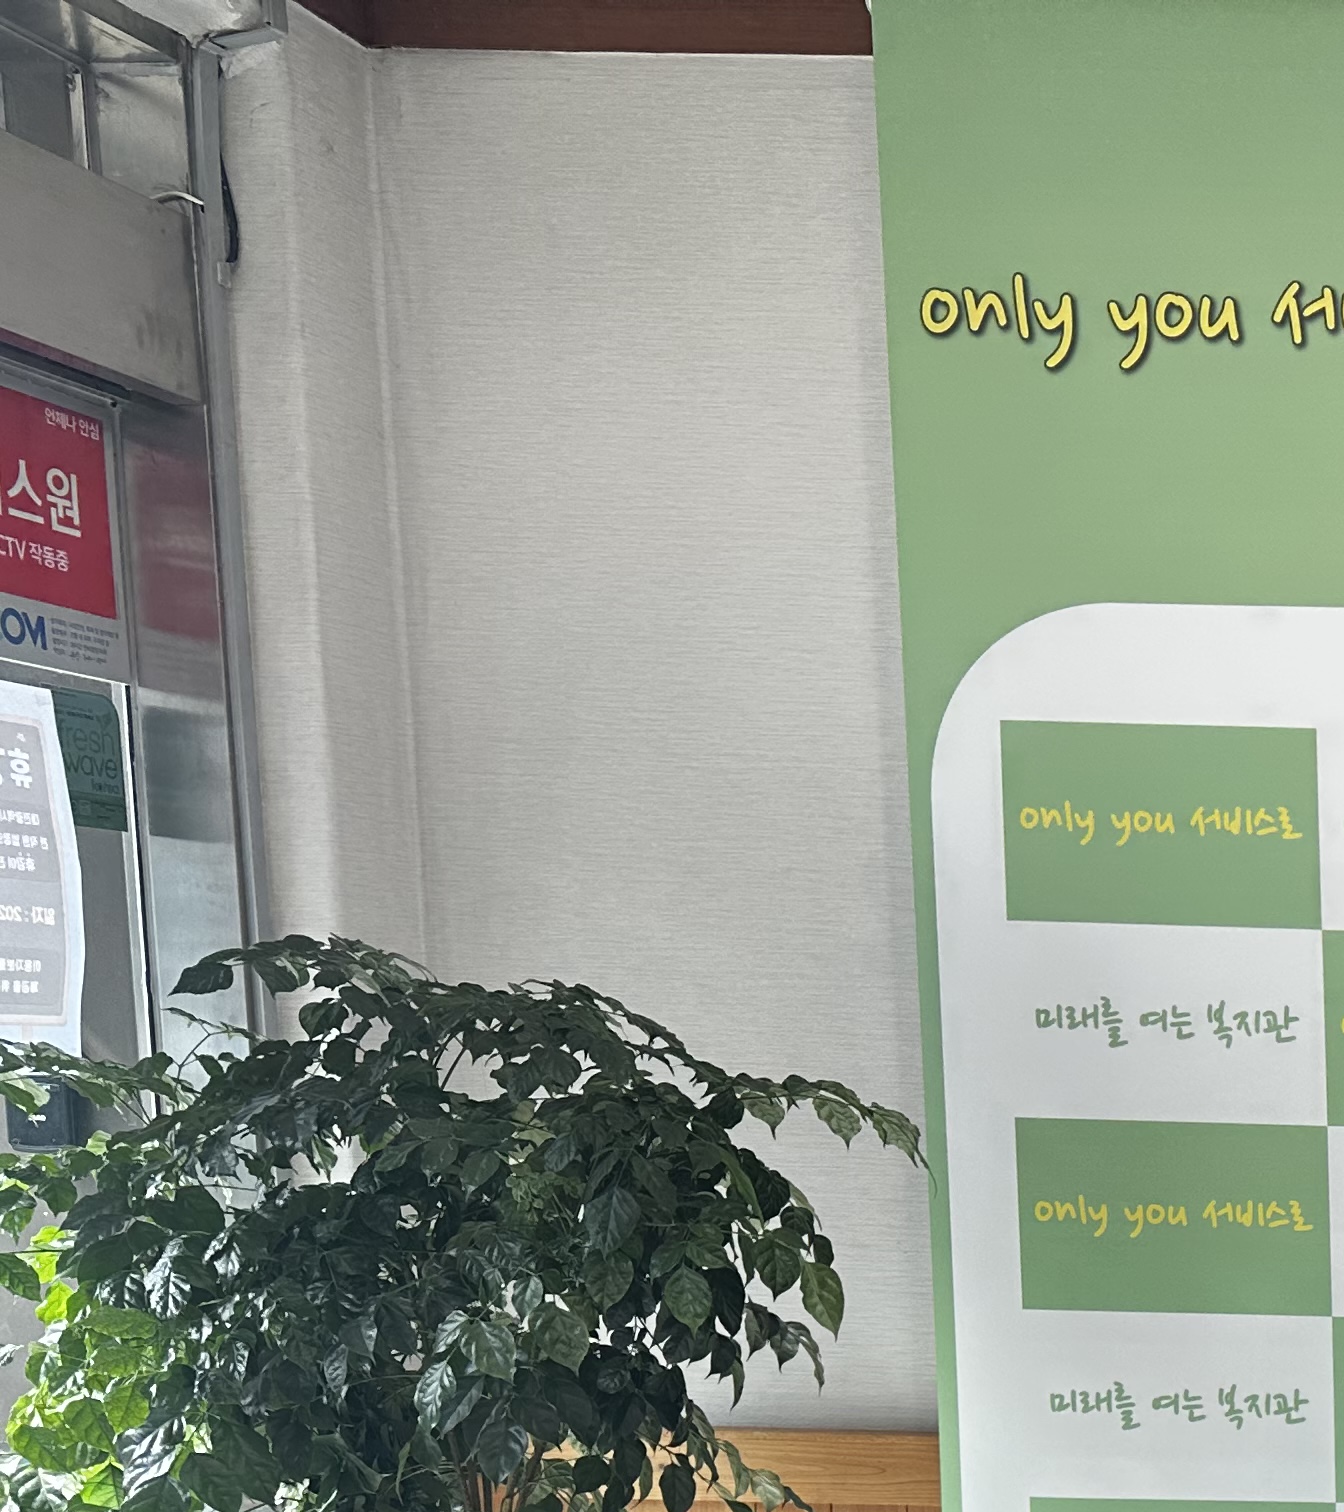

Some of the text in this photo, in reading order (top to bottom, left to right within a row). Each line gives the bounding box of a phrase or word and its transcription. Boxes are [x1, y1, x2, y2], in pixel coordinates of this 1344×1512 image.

[922, 277, 1072, 366] only
[1109, 294, 1238, 368] you
[44, 407, 100, 441] 언제나 안심
[0, 459, 82, 538] 스원
[29, 541, 70, 572] 작동중
[1020, 801, 1301, 845] only you 서비스로
[1035, 996, 1299, 1049] 미래를 여는 복지관
[1034, 1196, 1312, 1238] only you 서비스로
[1050, 1381, 1309, 1430] 미래를 여는 복지관
